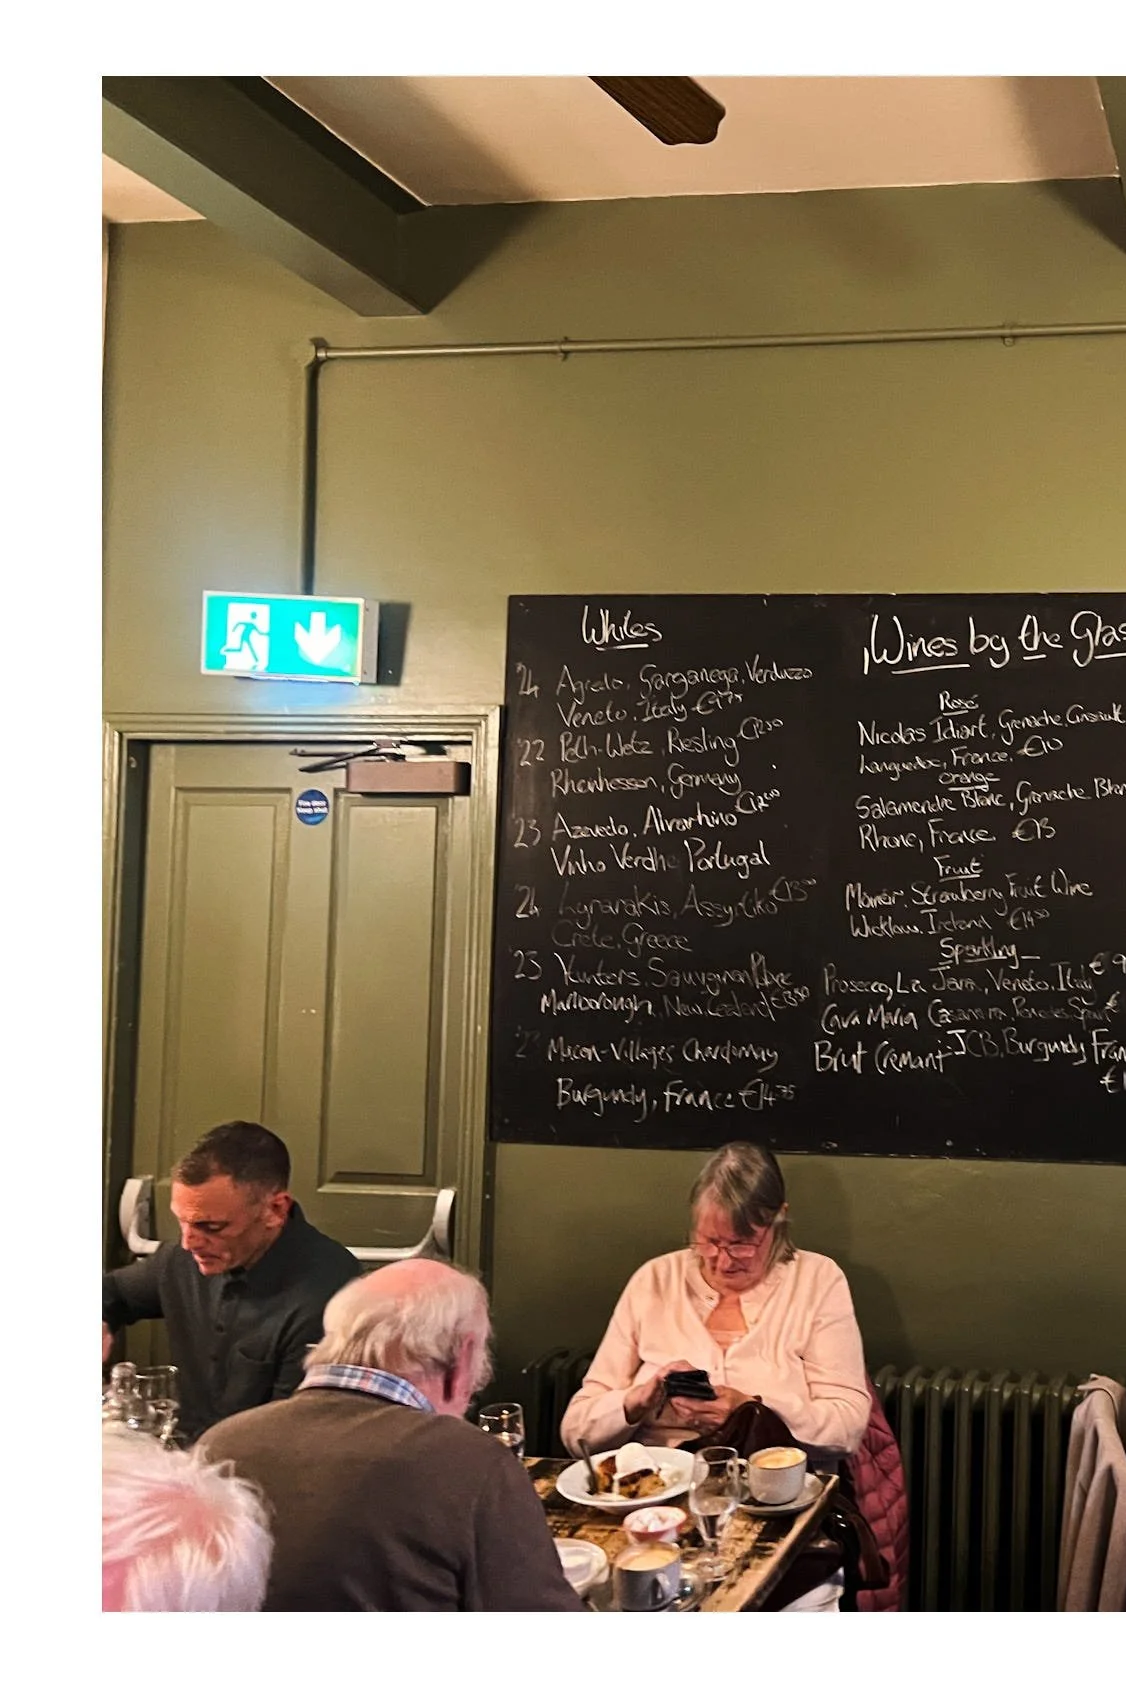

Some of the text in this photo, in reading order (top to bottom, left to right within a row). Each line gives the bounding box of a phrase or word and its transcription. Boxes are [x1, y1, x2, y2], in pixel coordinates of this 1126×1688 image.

[582, 605, 662, 646] Whites
[970, 616, 1009, 669] by
[1019, 614, 1063, 651] the
[858, 720, 927, 746] Nicolas
[684, 837, 771, 880] Portugal
[933, 854, 983, 877] Fruit
[1051, 867, 1094, 897] Wine
[896, 971, 927, 993] La
[814, 1039, 867, 1075] Brut
